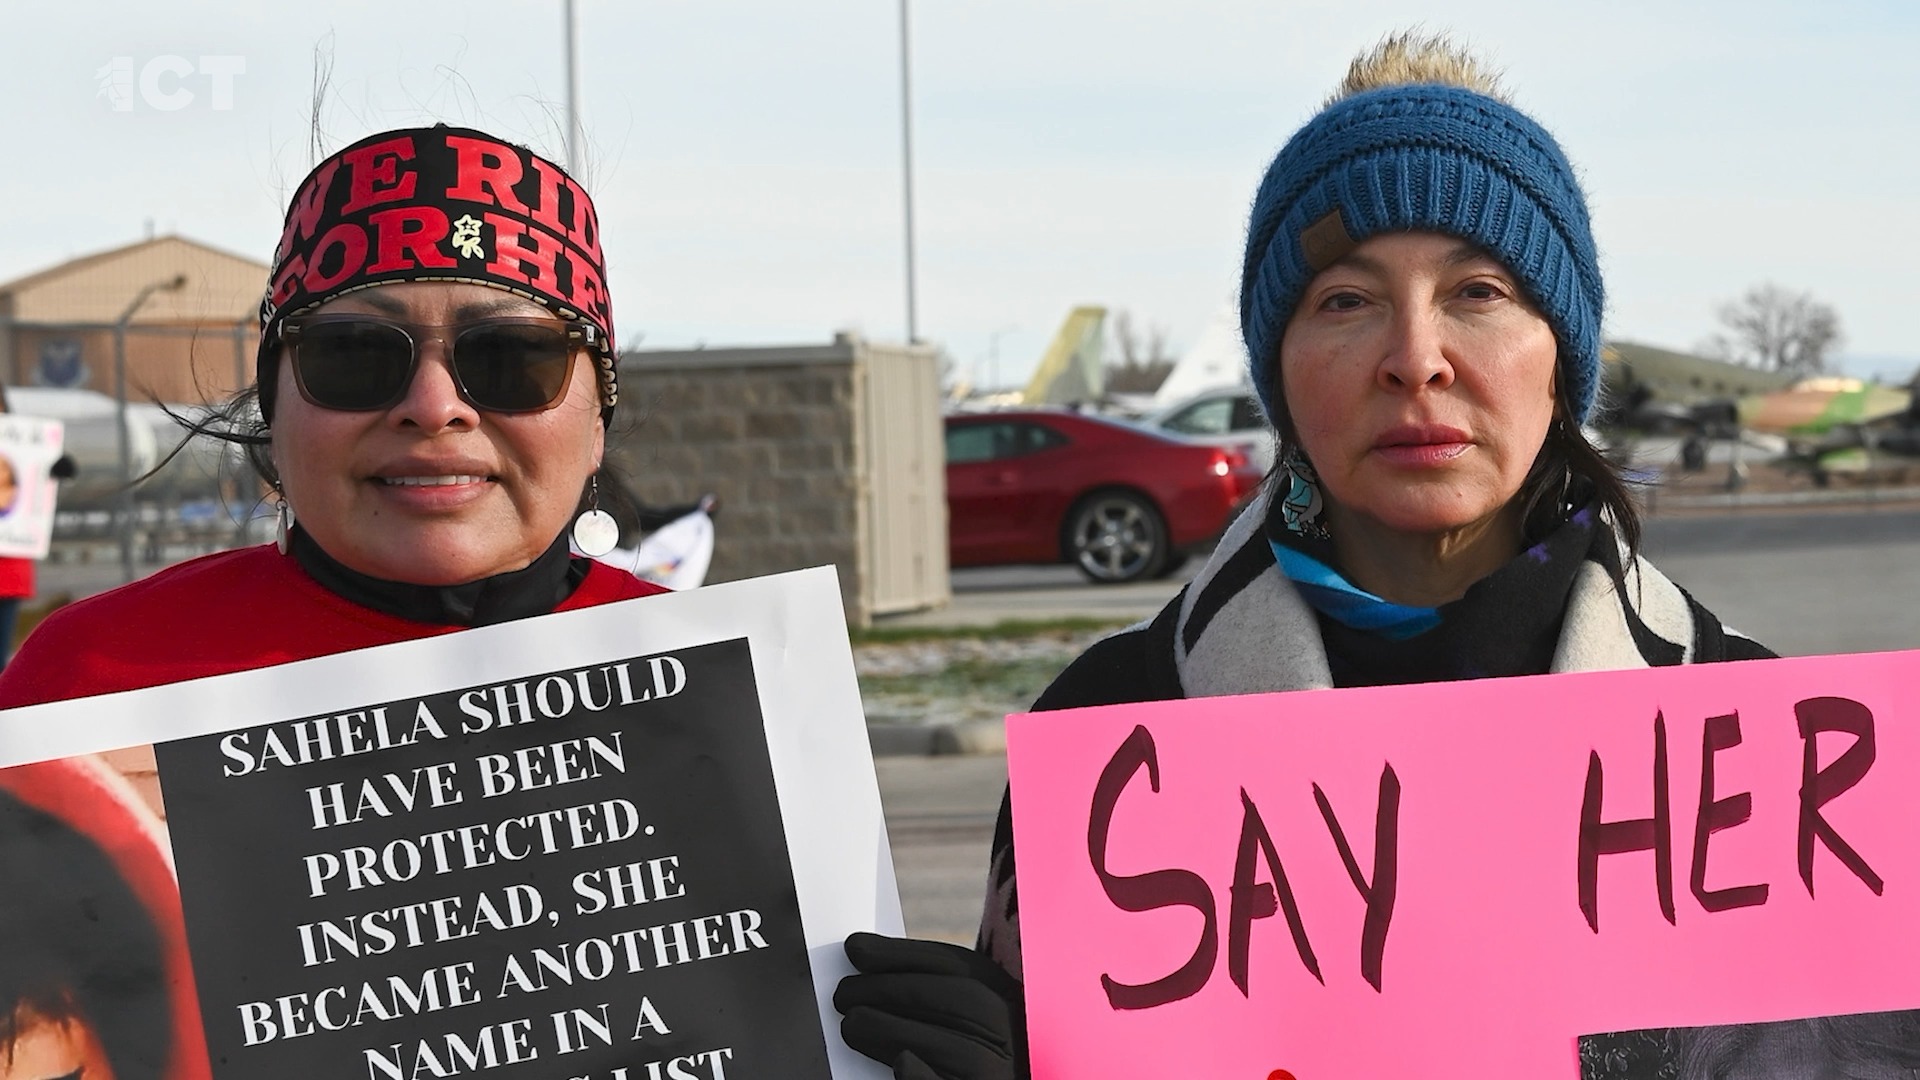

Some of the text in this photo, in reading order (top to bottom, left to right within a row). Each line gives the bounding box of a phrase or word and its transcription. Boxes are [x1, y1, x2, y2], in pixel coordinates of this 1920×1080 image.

[281, 135, 608, 282] WE RID
[483, 211, 616, 352] HE
[219, 656, 687, 777] SAHELA SHOULD
[305, 731, 626, 830] HAVE BEEN
[302, 798, 655, 898] PROTECTED.
[1087, 696, 1885, 1011] SAY HER
[296, 855, 686, 967] INSTEAD, SHE
[236, 909, 769, 1047] BECAME ANOTHER
[362, 996, 672, 1080] NAME IN A
[611, 1048, 733, 1080] ST
